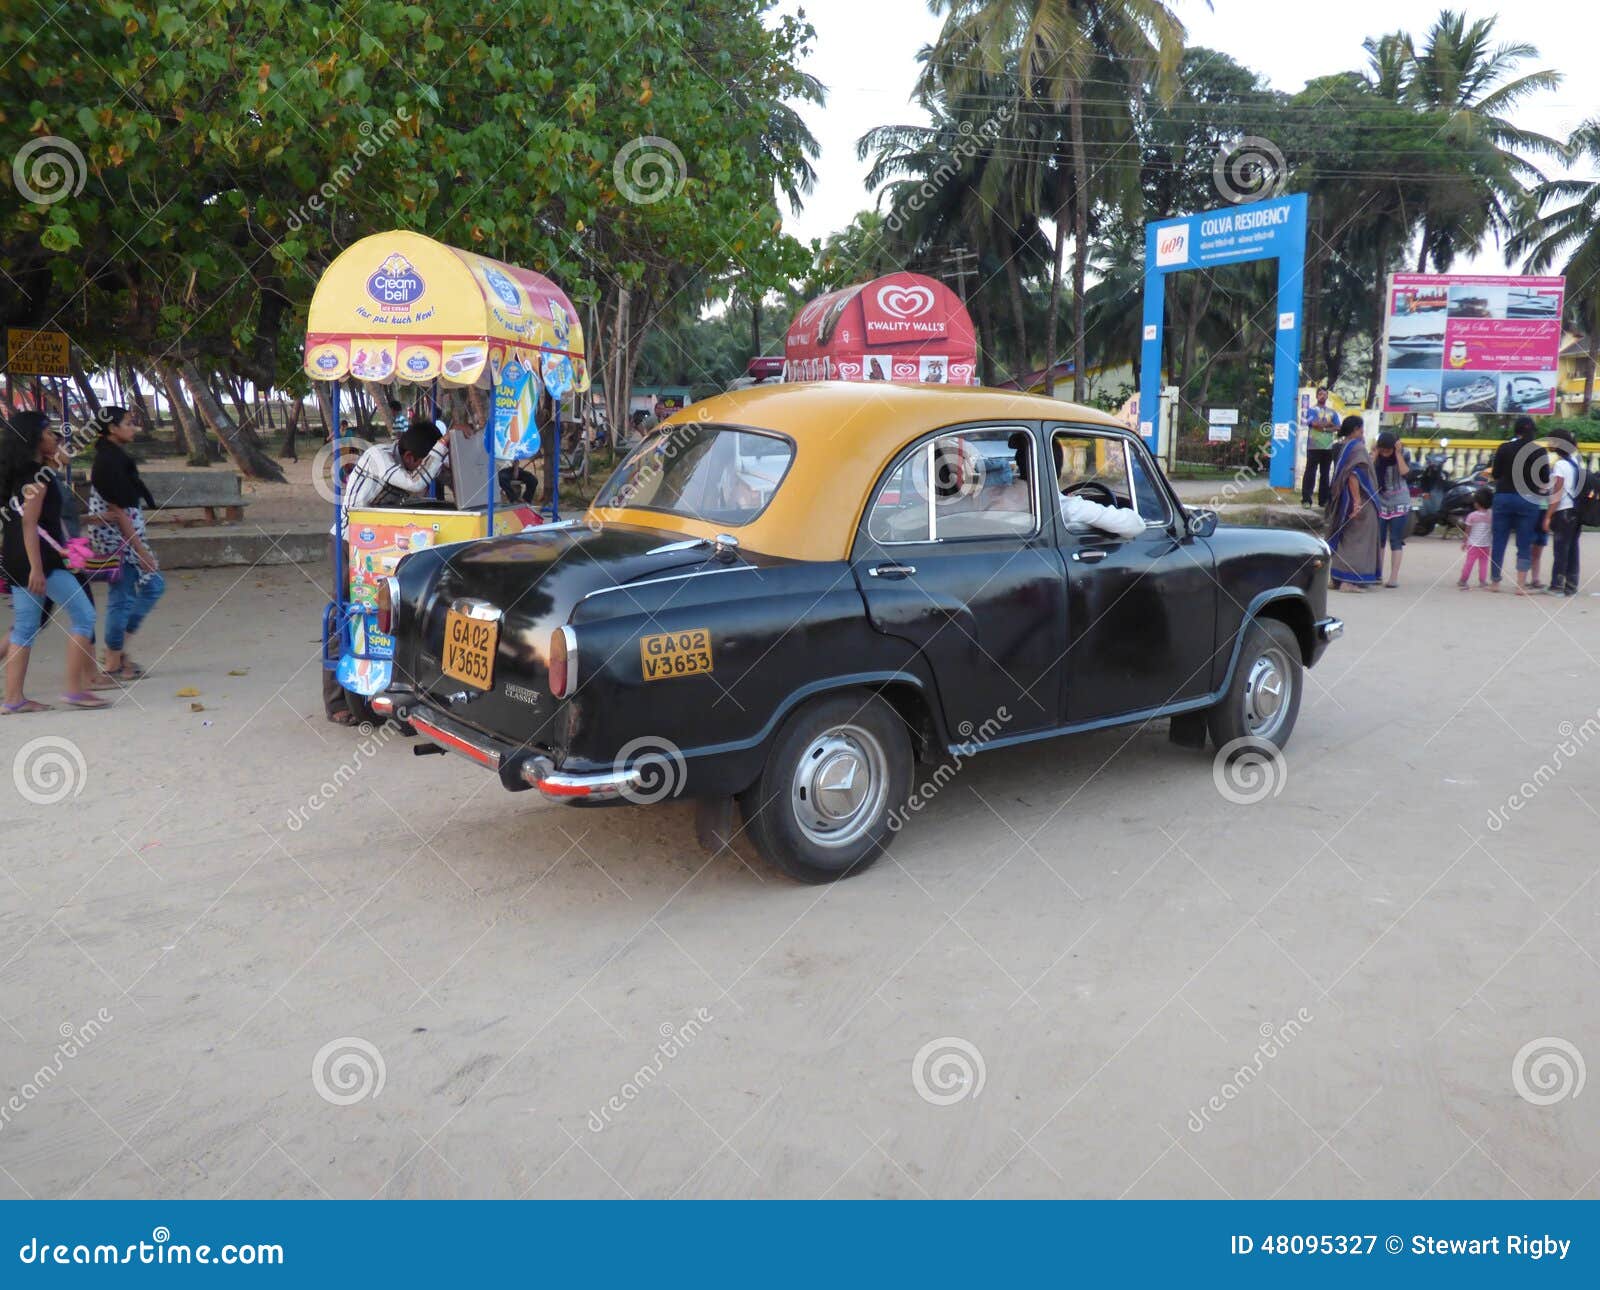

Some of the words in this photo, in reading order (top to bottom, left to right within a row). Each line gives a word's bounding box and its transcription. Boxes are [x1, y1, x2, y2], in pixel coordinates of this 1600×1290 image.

[1201, 221, 1232, 237] COLVA
[1235, 206, 1290, 231] RESIDENCY
[374, 276, 416, 289] Cream
[384, 288, 408, 301] bell
[868, 321, 911, 331] KWALITY
[913, 322, 945, 332] WALL'S
[369, 635, 391, 647] SPIN
